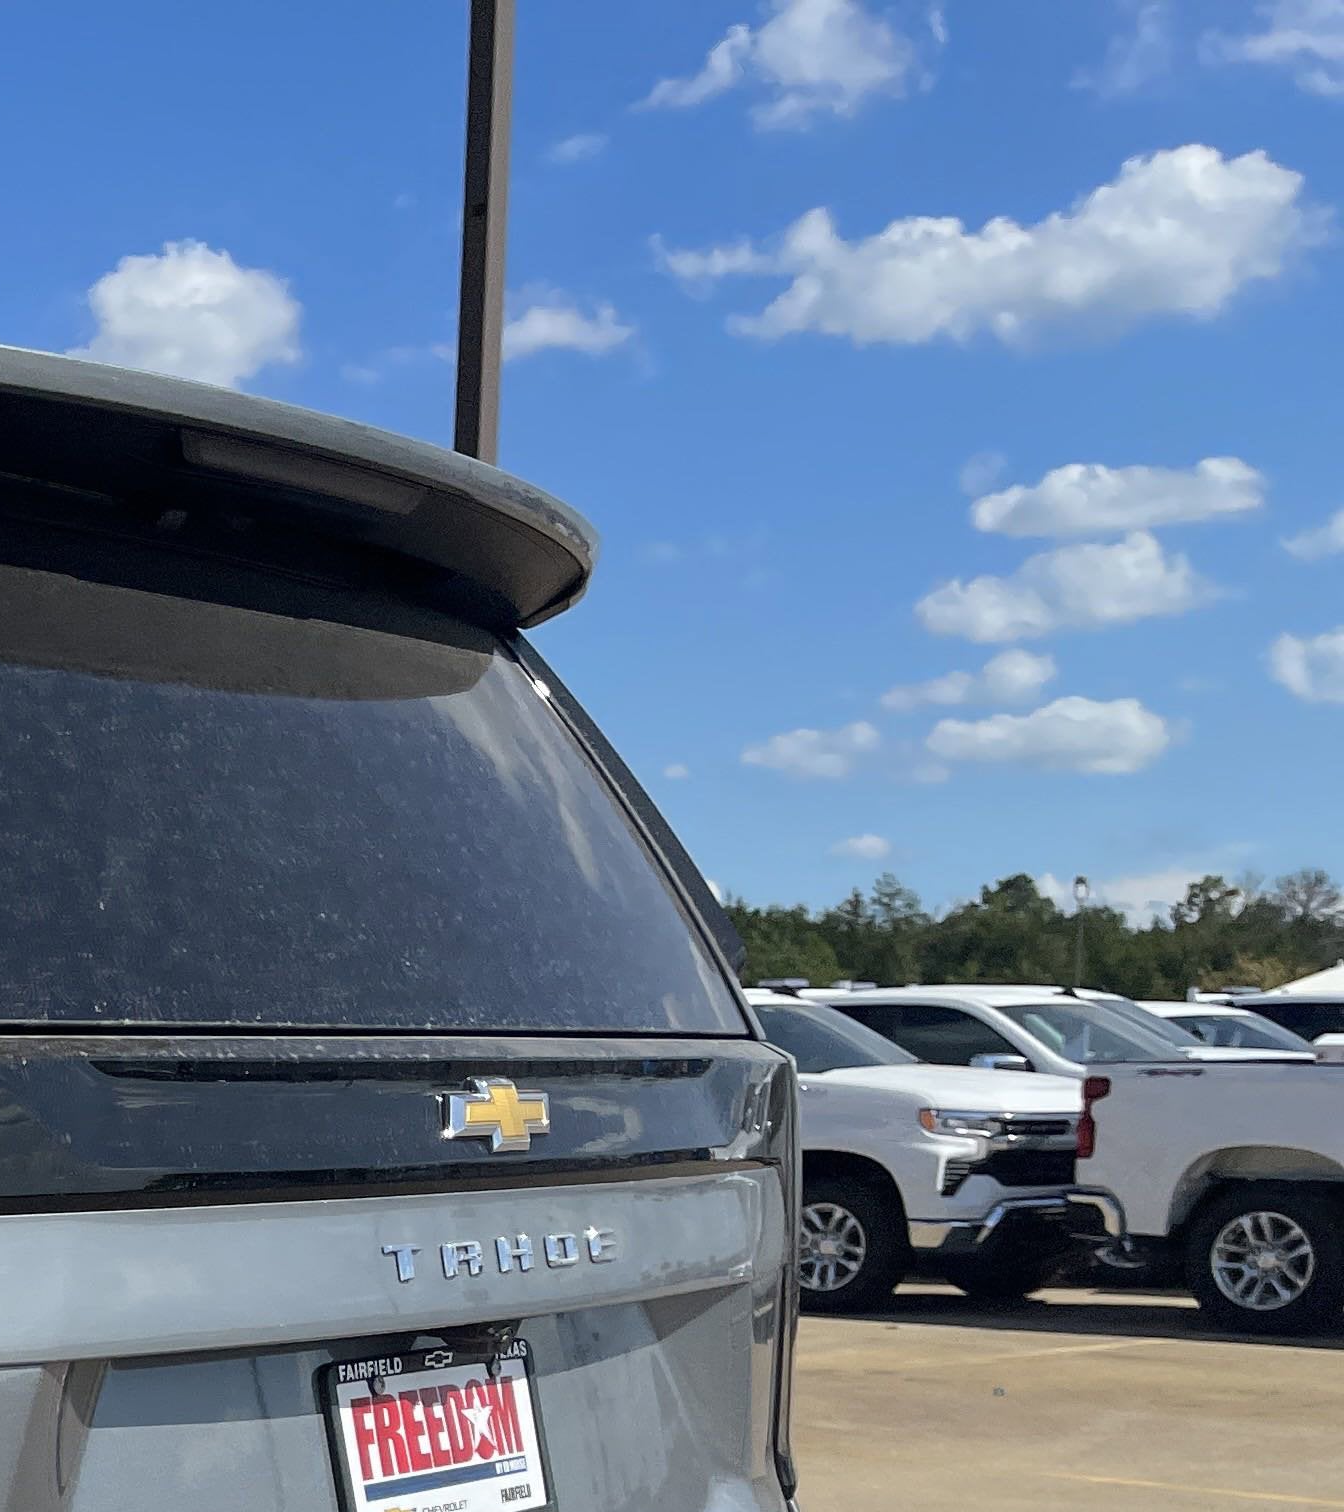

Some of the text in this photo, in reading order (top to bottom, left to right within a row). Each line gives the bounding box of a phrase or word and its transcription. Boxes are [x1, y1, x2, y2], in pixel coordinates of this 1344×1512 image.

[381, 1225, 617, 1283] TAHOE
[338, 1357, 403, 1382] FAIRFIELD
[350, 1376, 525, 1482] FREEDOM
